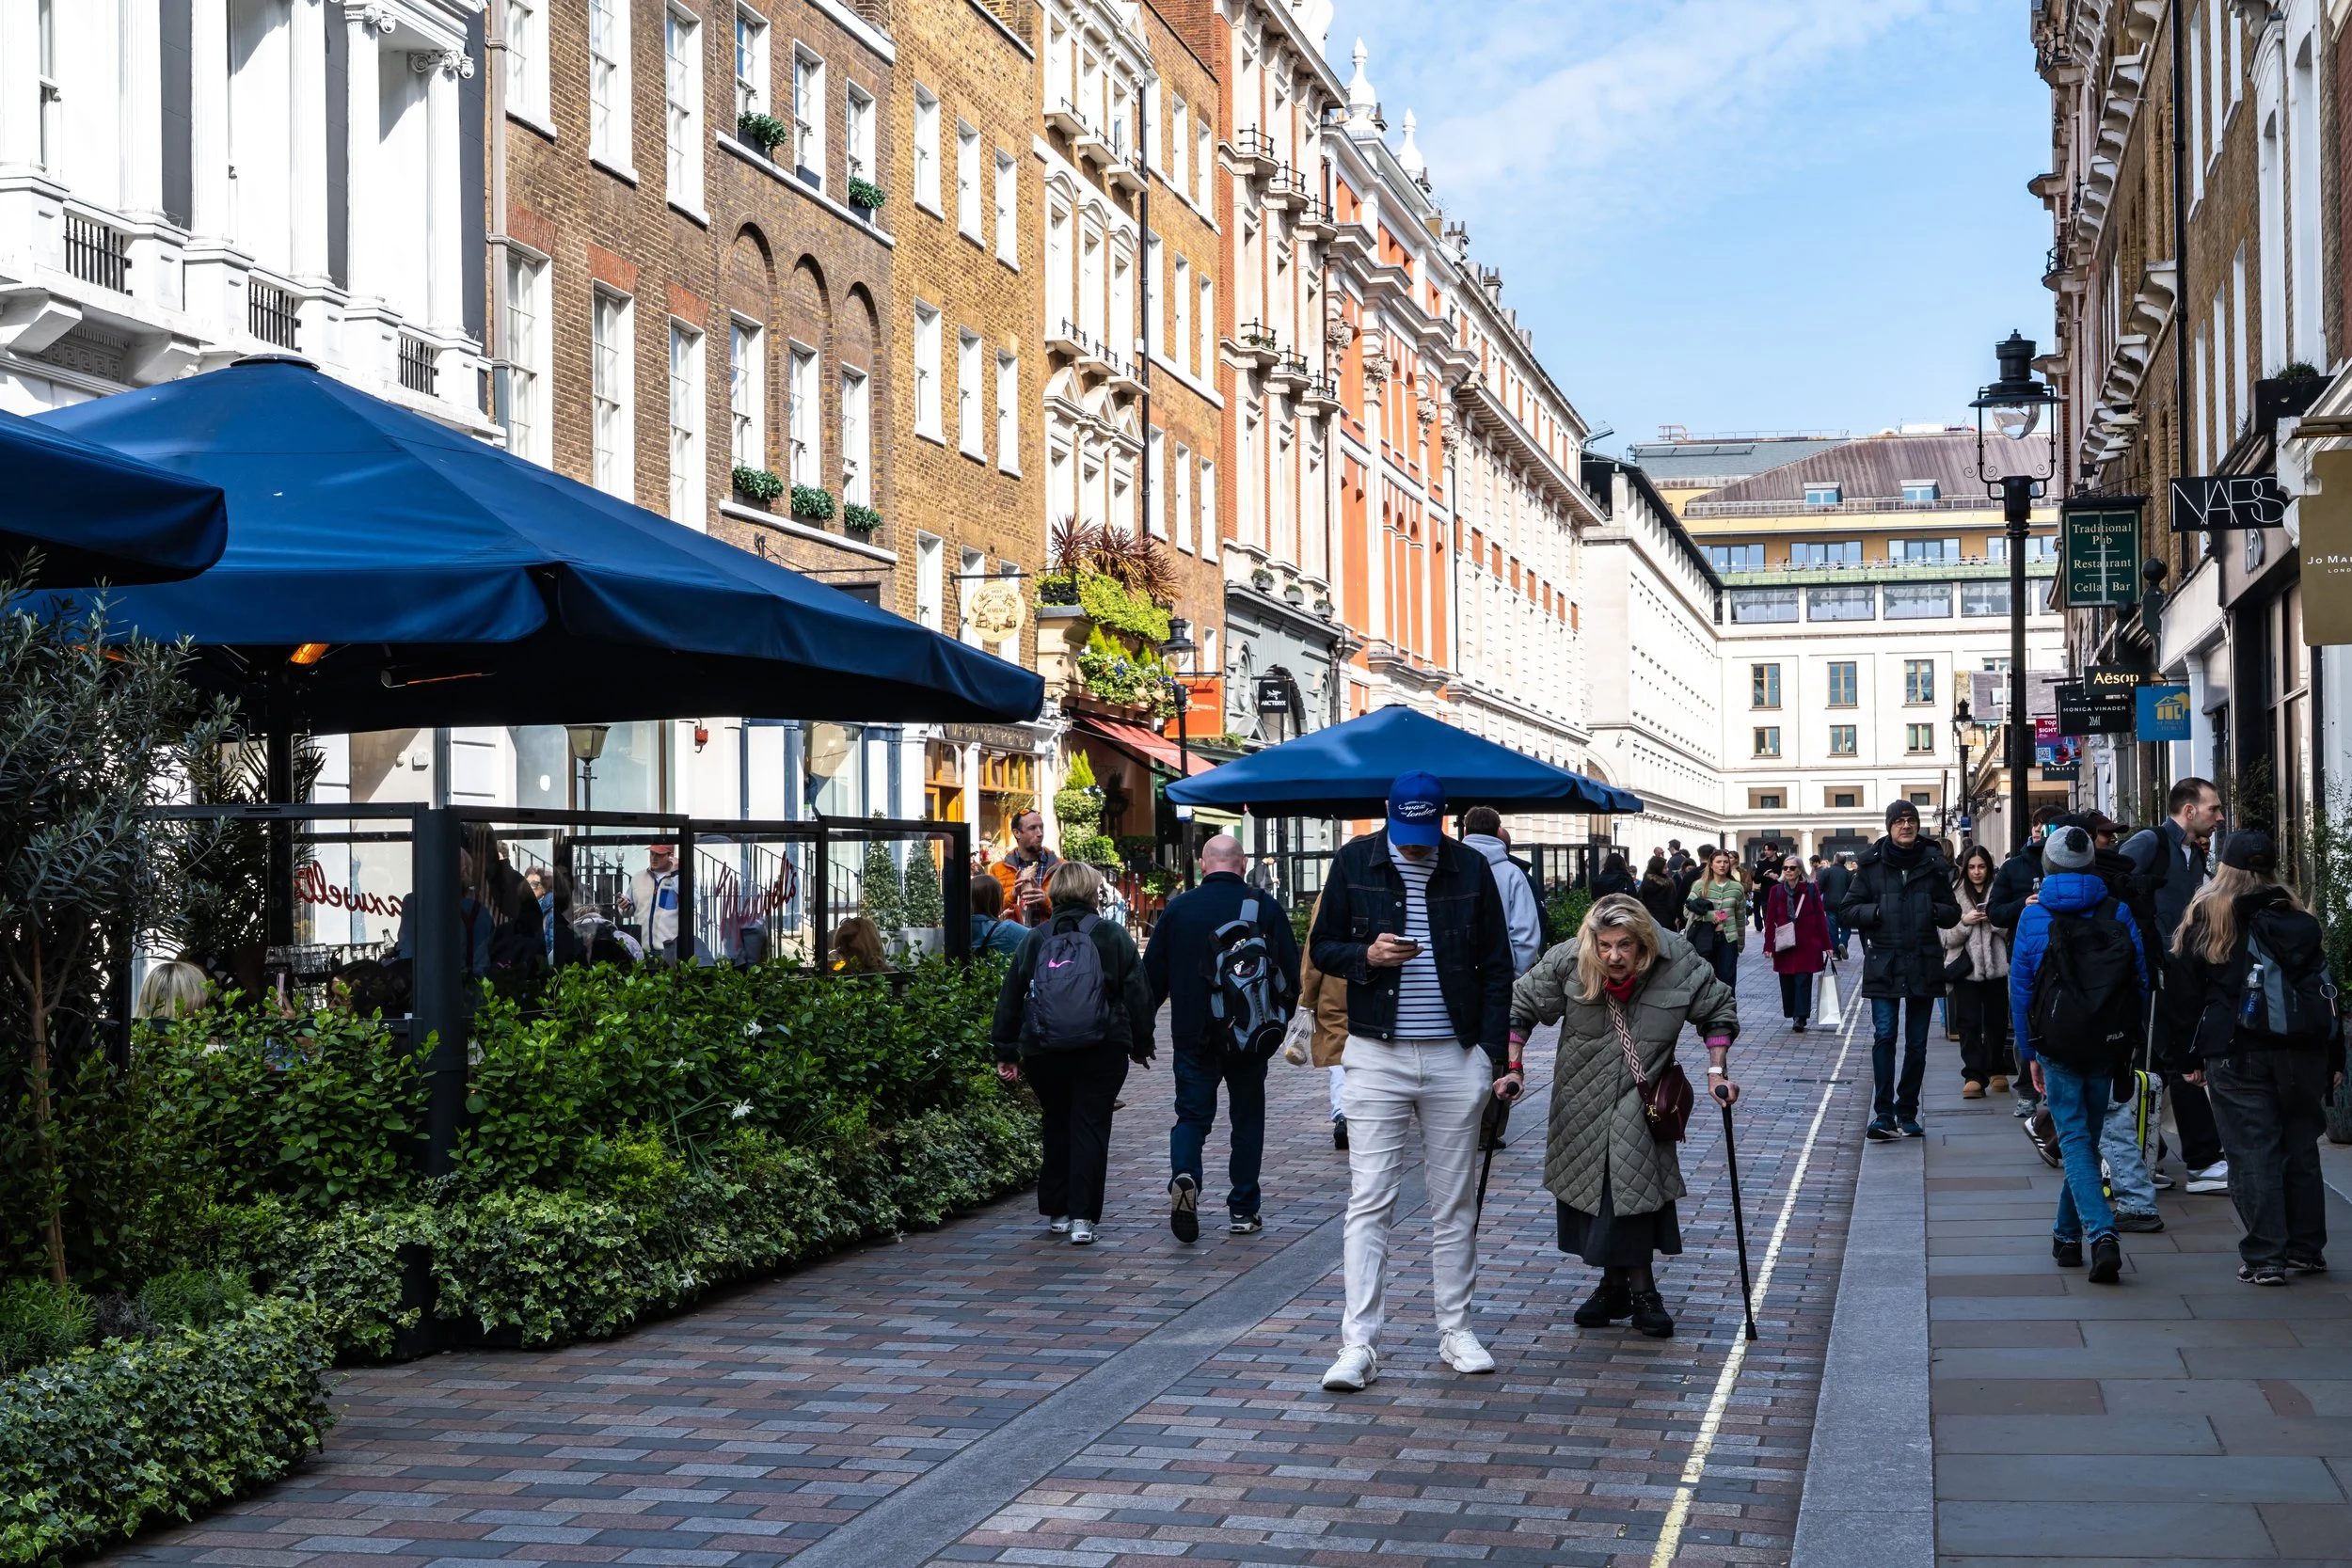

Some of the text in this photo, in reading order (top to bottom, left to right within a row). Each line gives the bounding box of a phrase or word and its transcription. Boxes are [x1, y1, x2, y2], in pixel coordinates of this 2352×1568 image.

[2171, 476, 2286, 527] NARS
[2072, 522, 2132, 534] Traditional
[2307, 556, 2323, 564] Jo
[2074, 581, 2131, 593] Cella Bar
[2106, 1031, 2124, 1042] FILA
